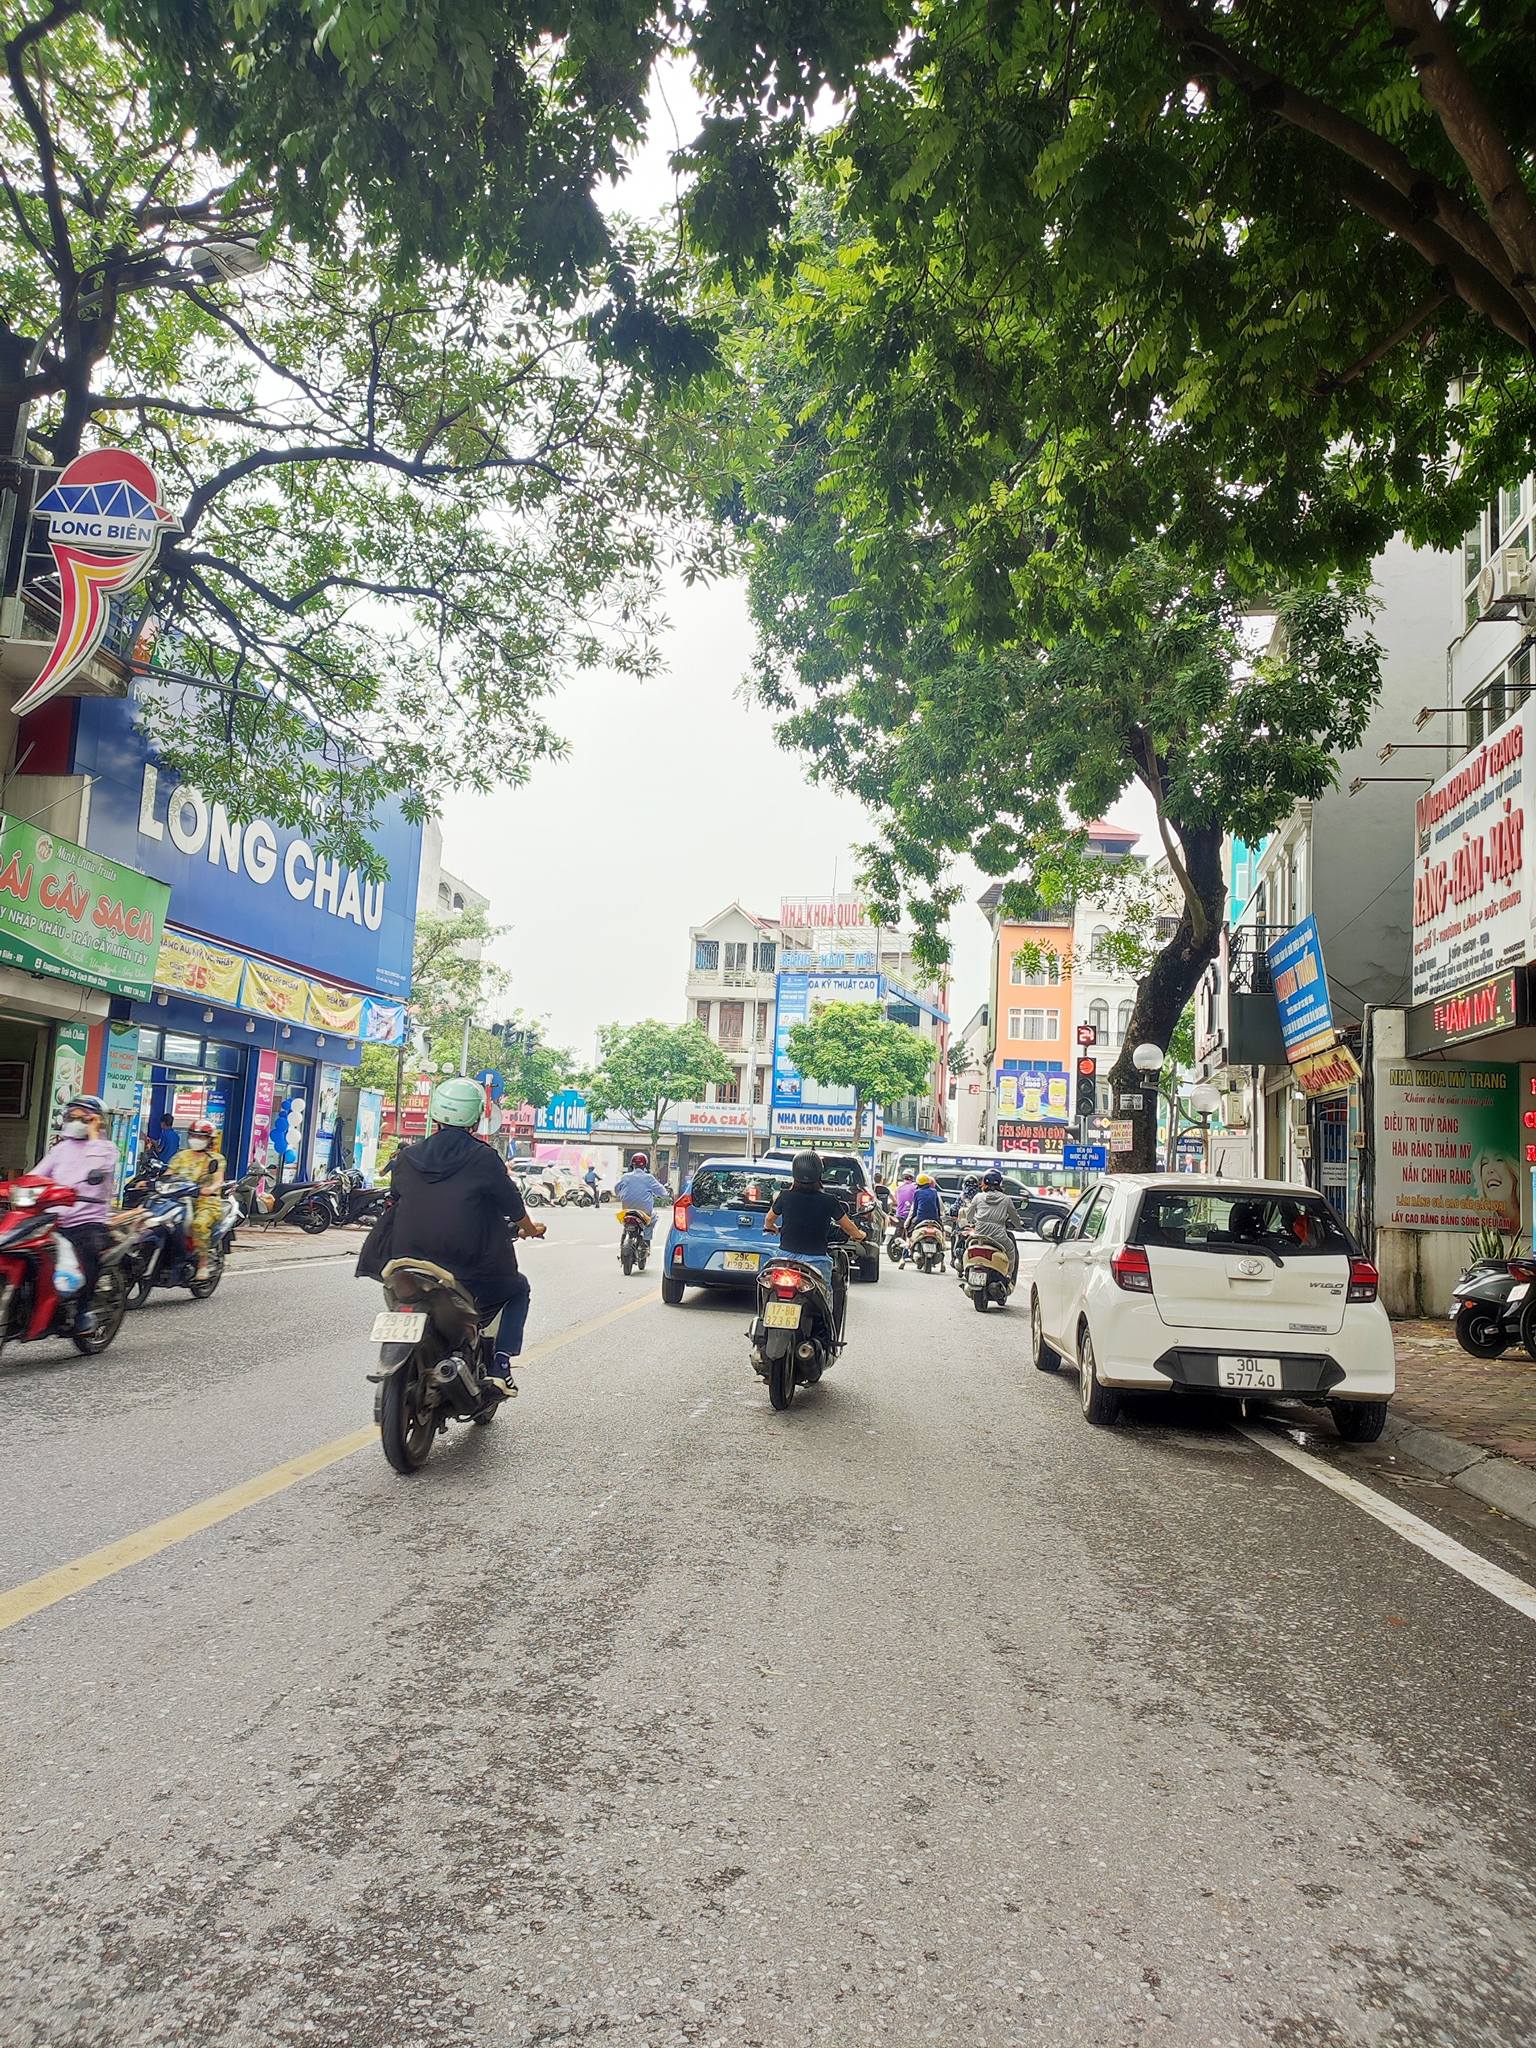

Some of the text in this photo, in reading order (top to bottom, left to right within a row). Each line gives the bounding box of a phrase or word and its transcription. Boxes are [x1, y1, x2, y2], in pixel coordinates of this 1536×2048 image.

[51, 519, 152, 542] LONG BIÊN
[138, 763, 277, 885] LONG
[0, 849, 155, 946] ÁI CÂY SẠCH
[8, 909, 37, 931] NHẬP
[71, 929, 91, 949] TRÁI
[834, 978, 858, 991] THUẬT
[858, 980, 875, 990] CAO
[1390, 1068, 1507, 1089] NHA KHOA MỸ TRANG
[554, 1101, 565, 1129] CÁ
[689, 1111, 757, 1126] HÓA CHẤ
[777, 1110, 853, 1127] NHA KHOA QUỐC
[1384, 1111, 1403, 1131] ĐIỀU
[1404, 1115, 1417, 1135] TRỊ
[1436, 1115, 1459, 1134] RĂNG
[1015, 1123, 1032, 1139] SÀO
[1032, 1124, 1048, 1139] SÀI
[1392, 1136, 1472, 1159] HÀN RĂNG THẨM MỸ
[1421, 1163, 1447, 1184] CHỈNH
[1449, 1167, 1472, 1185] RĂNG
[1391, 1209, 1404, 1223] LẤY
[1405, 1213, 1419, 1223] CAO
[1420, 1212, 1439, 1225] RĂNG
[1460, 1213, 1480, 1227] SÓNG
[734, 1253, 750, 1261] 29K
[1237, 1358, 1264, 1372] 30L
[1226, 1372, 1275, 1388] 577.40
